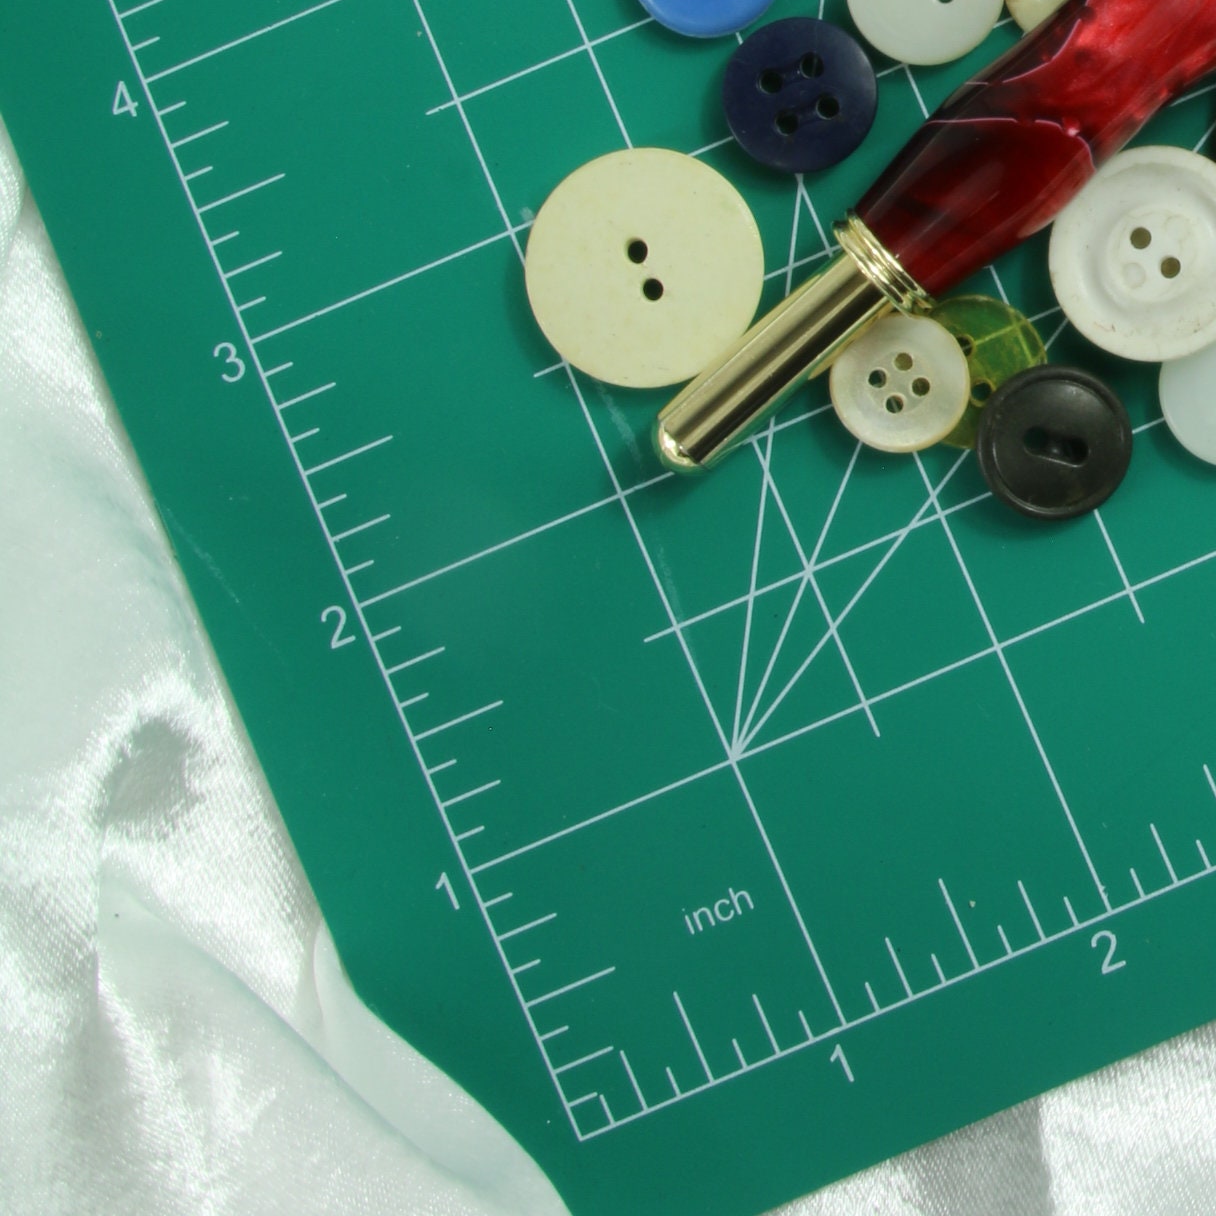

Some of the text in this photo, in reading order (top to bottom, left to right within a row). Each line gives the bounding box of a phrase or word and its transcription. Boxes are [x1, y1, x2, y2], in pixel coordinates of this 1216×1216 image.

[111, 80, 139, 118] 4
[212, 341, 246, 383] 3
[320, 604, 356, 650] 2
[434, 871, 461, 911] 1
[681, 887, 755, 936] inch
[1090, 929, 1127, 976] 2
[829, 1043, 855, 1083] 1
